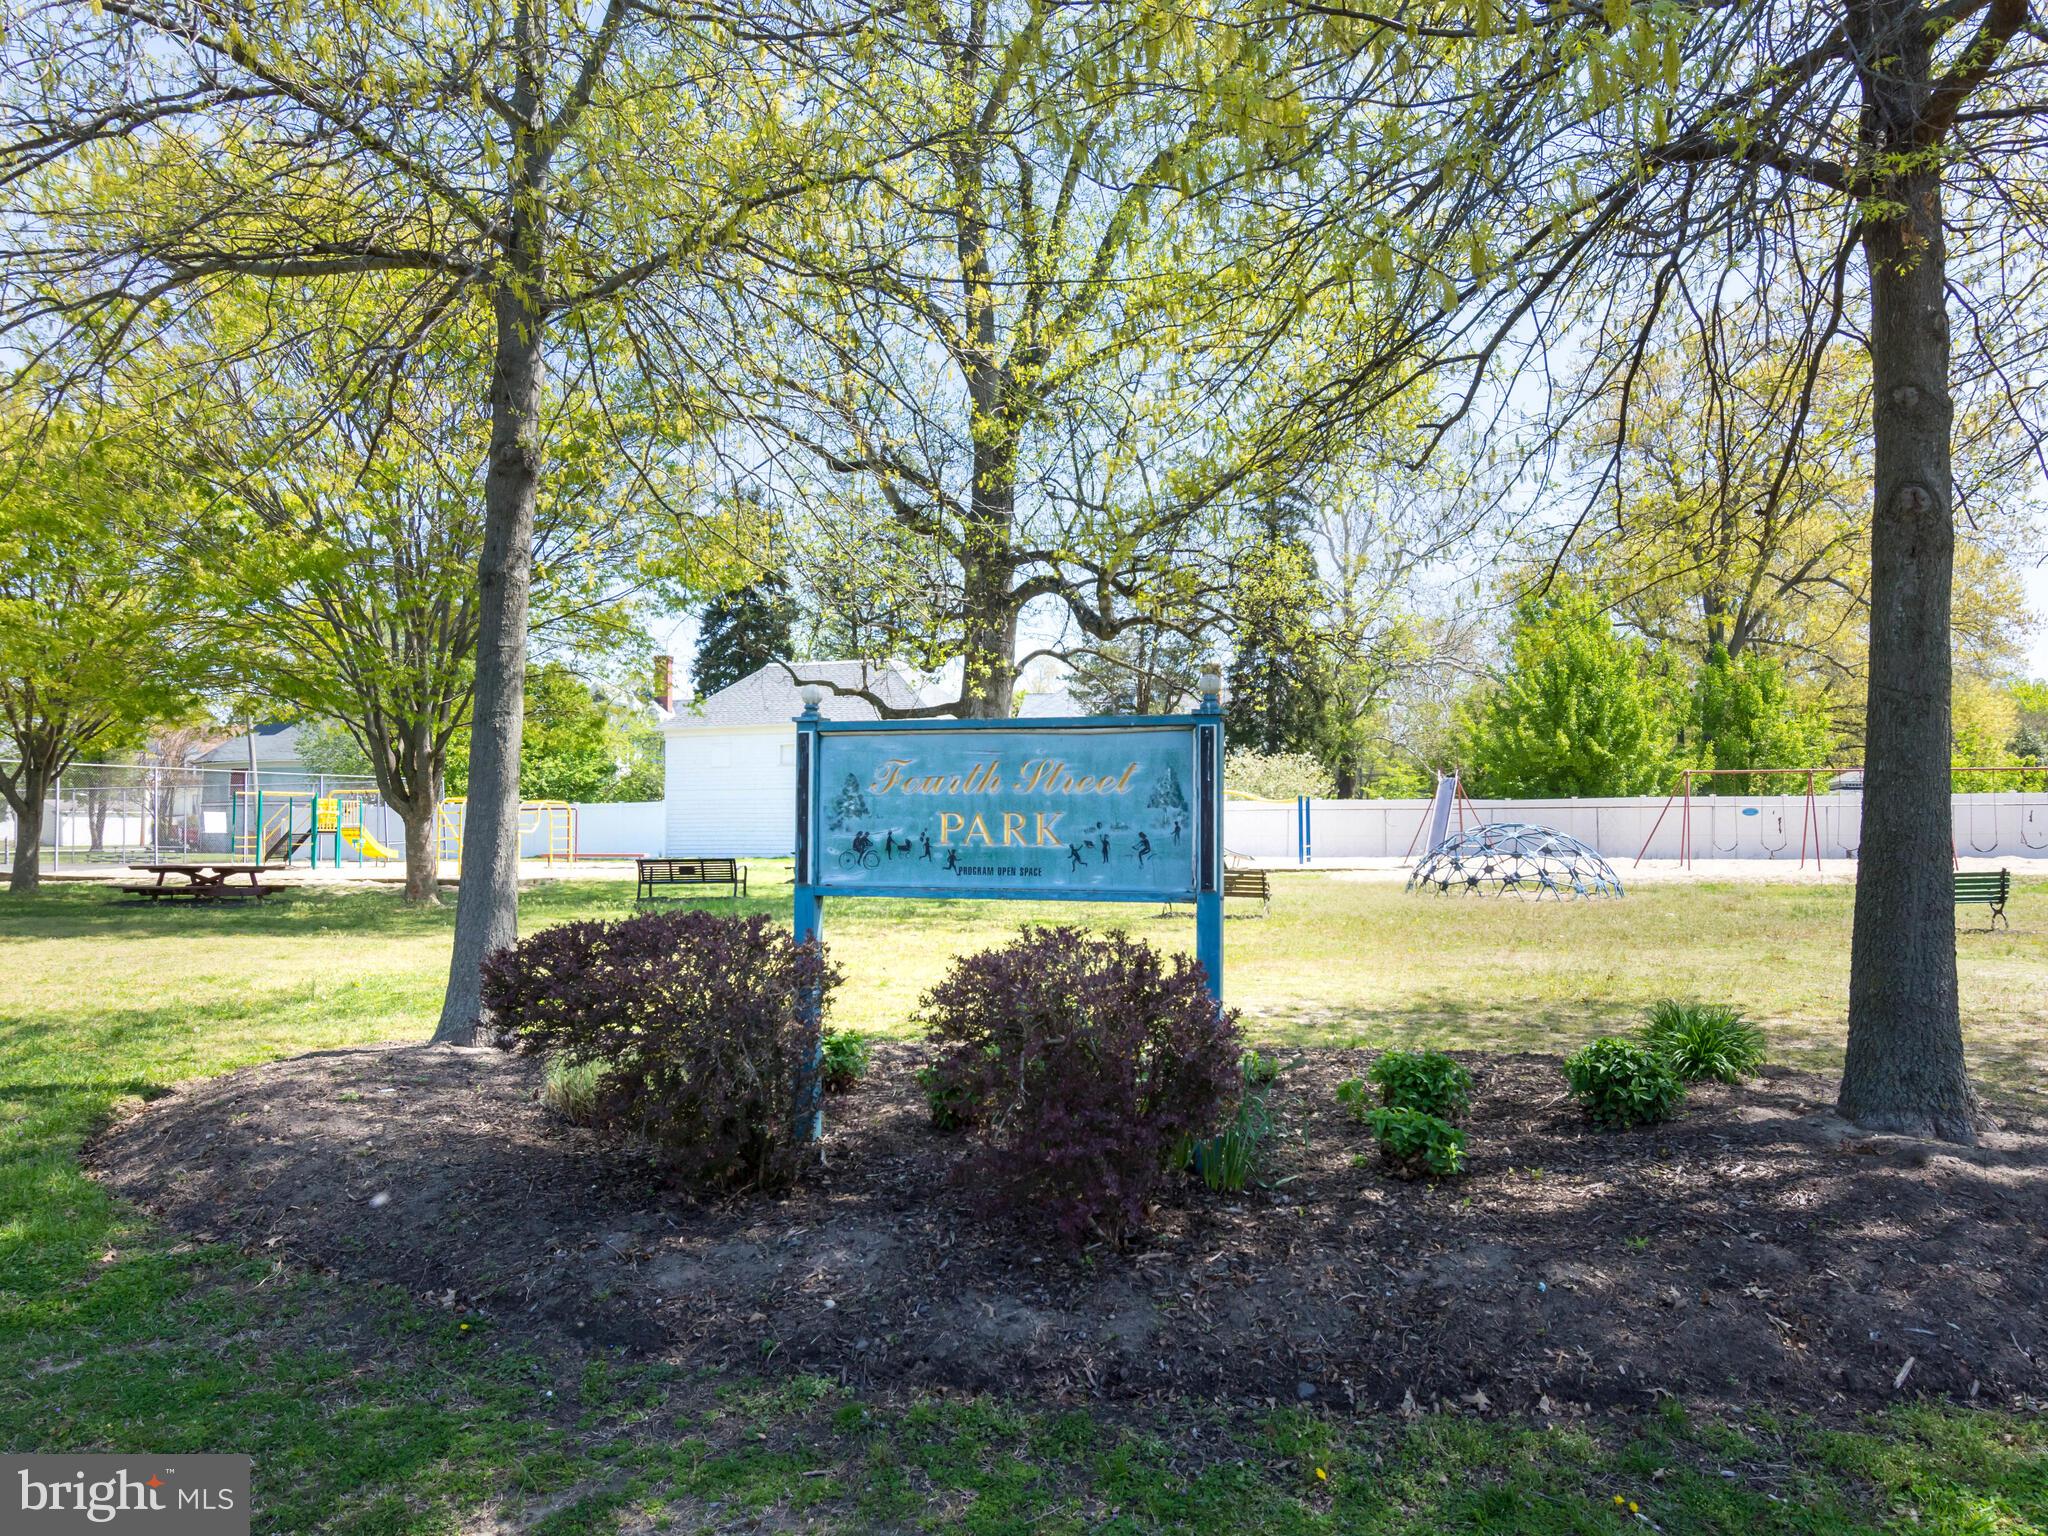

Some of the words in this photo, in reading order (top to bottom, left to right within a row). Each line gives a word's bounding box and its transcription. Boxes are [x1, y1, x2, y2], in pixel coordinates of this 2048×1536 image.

[868, 758, 1001, 795] Fourth
[1013, 757, 1140, 796] Street
[938, 811, 1067, 848] PARK
[959, 866, 994, 877] PROGRAM
[997, 866, 1016, 877] OPEN
[1019, 866, 1042, 877] SPACE
